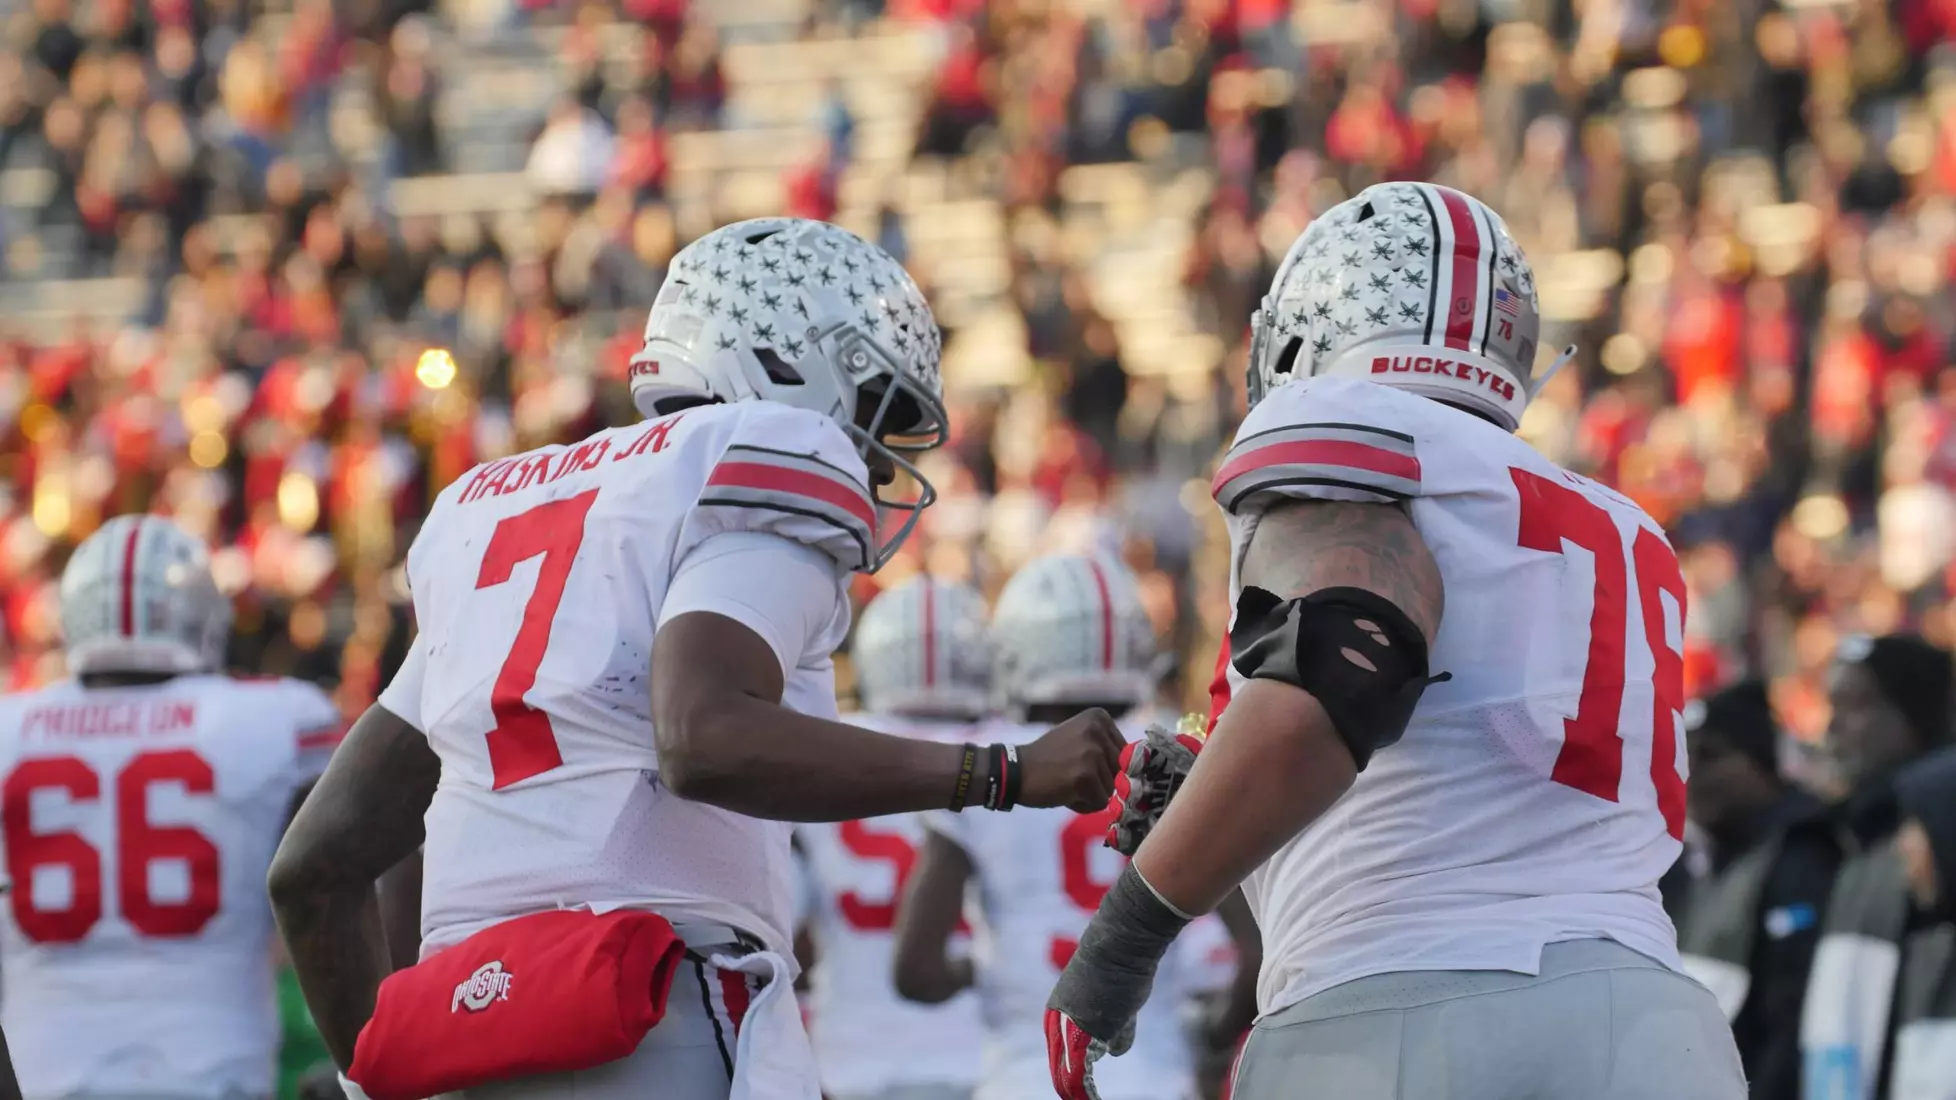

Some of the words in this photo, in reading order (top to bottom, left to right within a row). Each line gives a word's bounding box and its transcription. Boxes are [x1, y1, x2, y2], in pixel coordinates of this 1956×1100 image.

[1371, 357, 1516, 401] BUCKEYES
[1497, 318, 1513, 341] 78
[457, 437, 612, 504] HASKINS
[613, 413, 686, 462] JR.
[475, 487, 601, 788] 7
[1508, 466, 1688, 843] 78
[1, 748, 222, 946] 66
